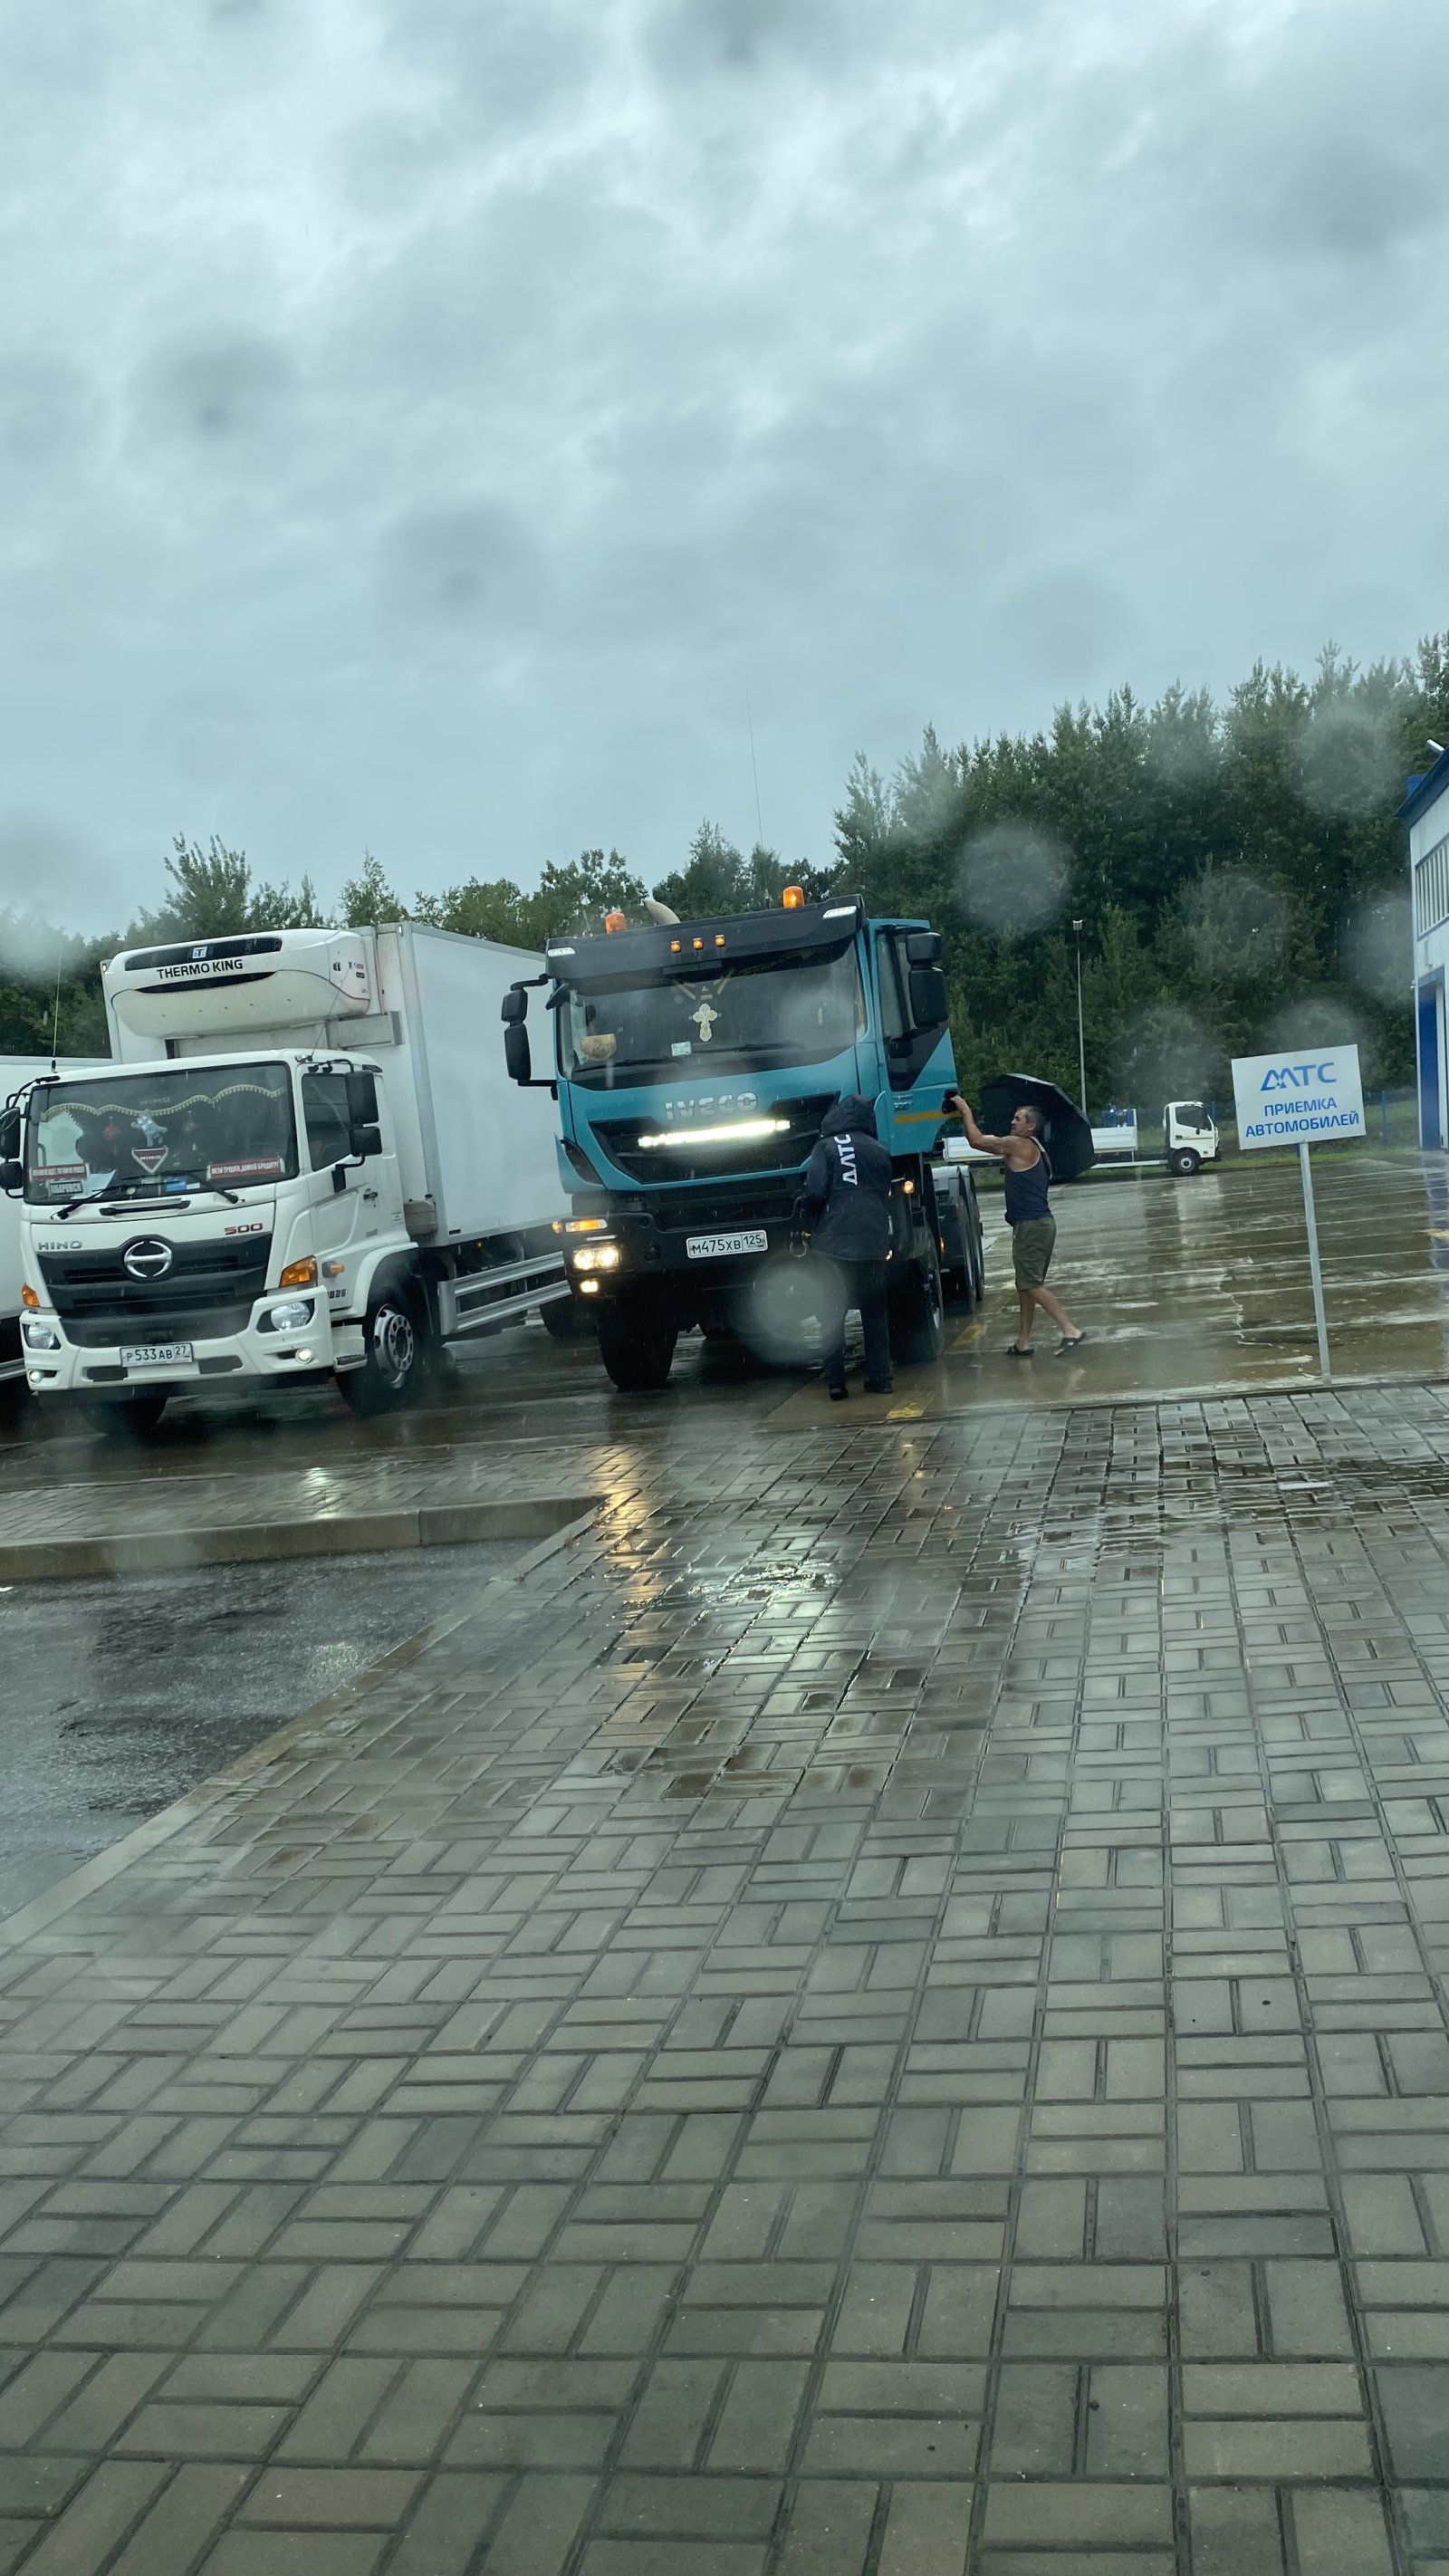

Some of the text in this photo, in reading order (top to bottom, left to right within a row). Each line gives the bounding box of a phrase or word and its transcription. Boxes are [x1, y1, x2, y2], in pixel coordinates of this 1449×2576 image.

[157, 959, 243, 979] THERMO KING
[665, 1092, 758, 1121] IVECO
[1264, 1097, 1338, 1117] ПРИЕМКА
[1245, 1110, 1359, 1138] АВТОМОБИЛЕЙ
[225, 1223, 264, 1235] 500
[38, 1240, 82, 1250] HINO
[744, 1235, 762, 1245] 125
[175, 1345, 187, 1356] 27
